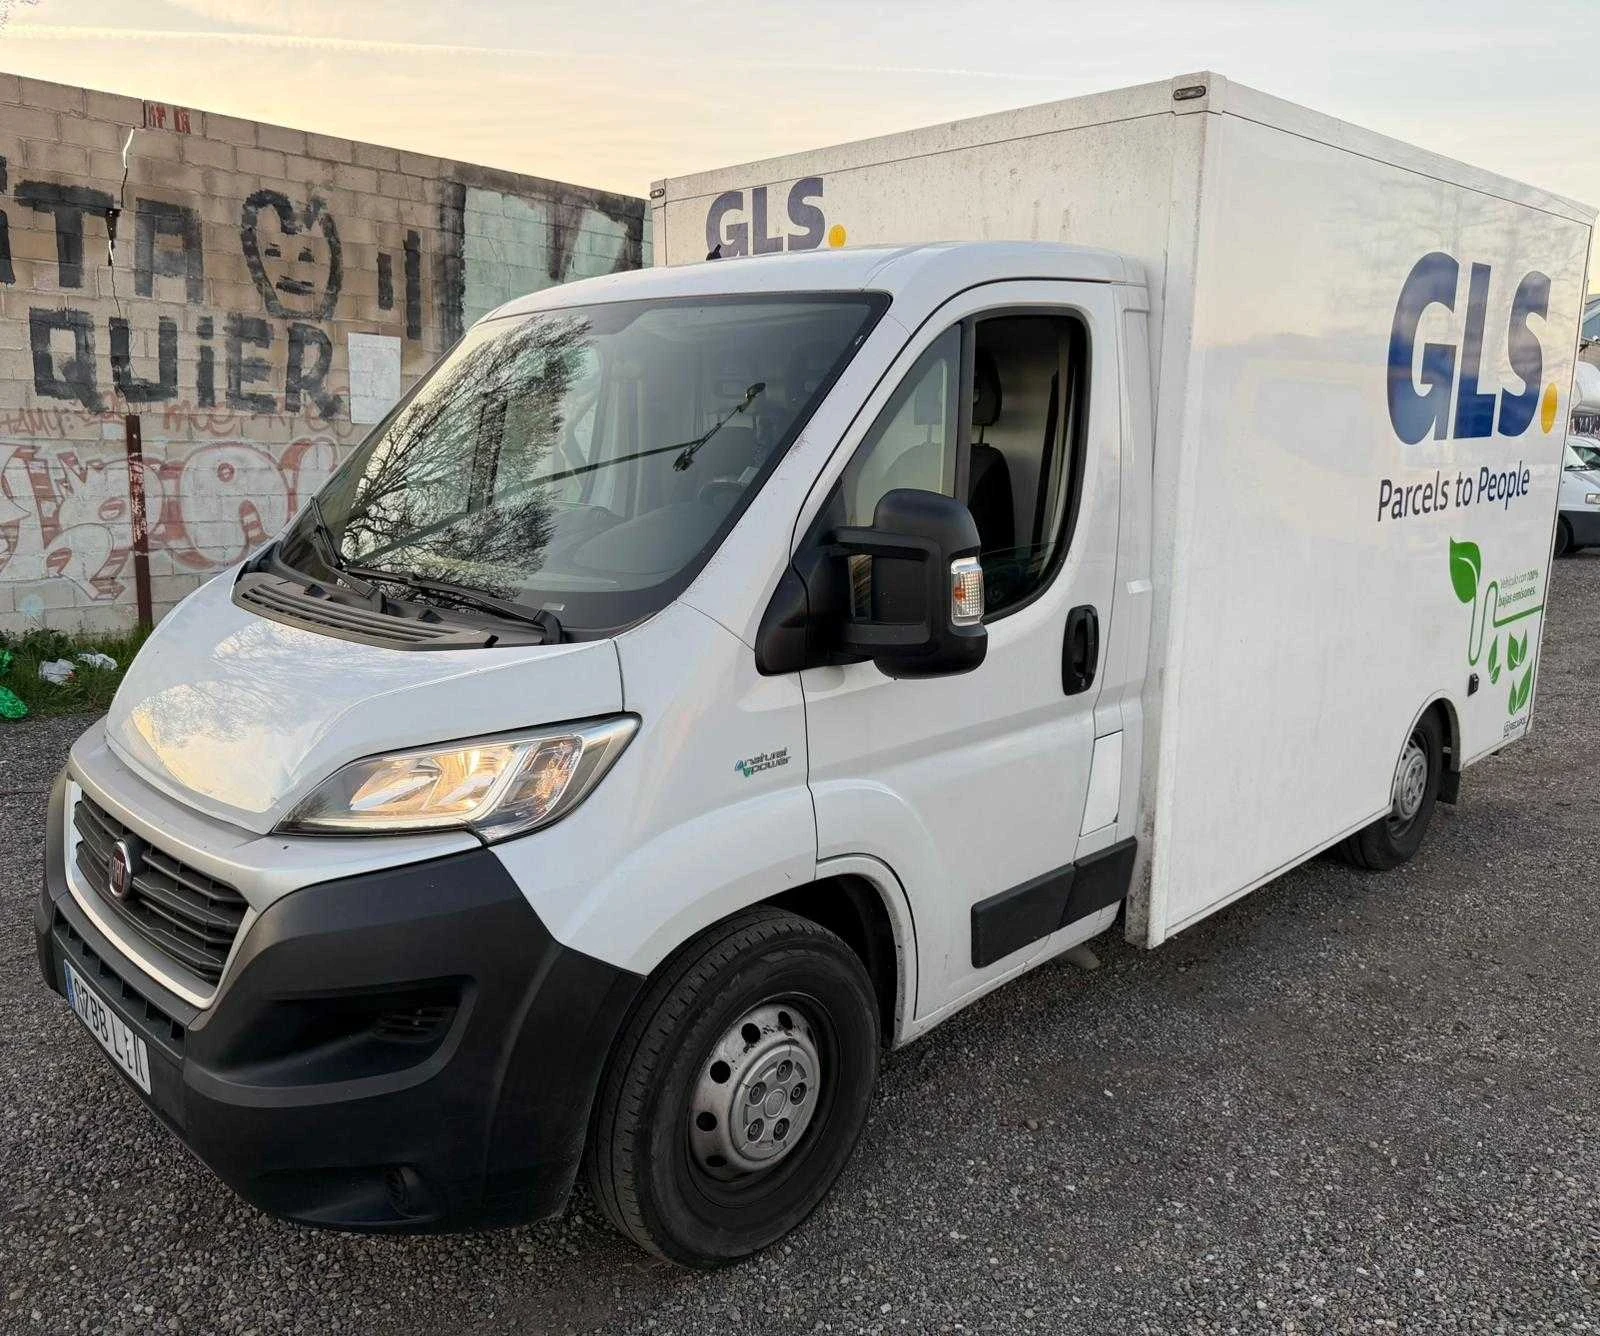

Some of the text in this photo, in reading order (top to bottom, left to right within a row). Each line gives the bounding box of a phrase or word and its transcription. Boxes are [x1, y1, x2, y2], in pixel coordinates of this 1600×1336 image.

[1378, 460, 1531, 522] Parcels to People
[747, 746, 788, 766] natural
